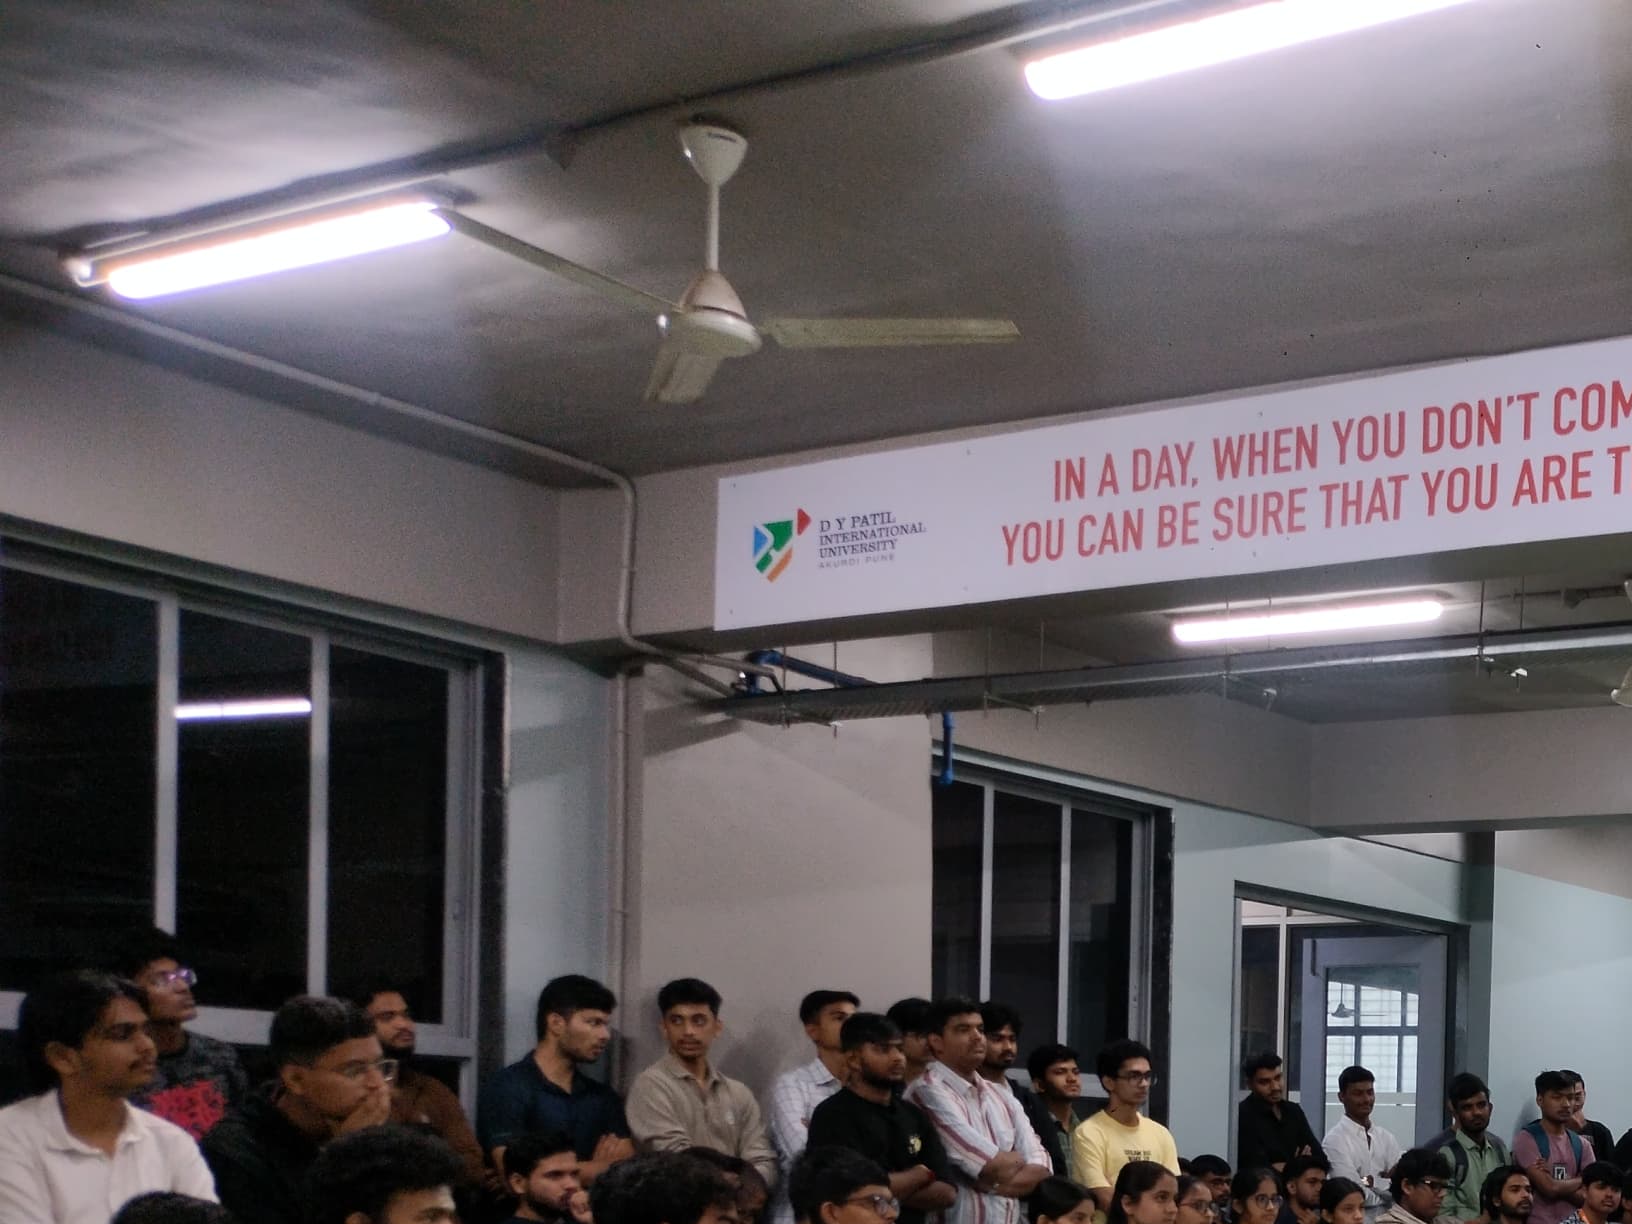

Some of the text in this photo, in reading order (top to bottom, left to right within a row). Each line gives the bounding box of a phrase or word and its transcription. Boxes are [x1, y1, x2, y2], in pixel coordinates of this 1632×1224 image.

[1054, 457, 1087, 503] IN
[1097, 454, 1120, 496] A
[1131, 442, 1200, 492] DAY,
[1212, 425, 1319, 481] WHEN
[1332, 411, 1406, 465] YOU
[1421, 391, 1540, 454] DON'T
[1002, 518, 1065, 566] YOU
[1076, 508, 1144, 558] CAN
[1156, 501, 1200, 549] BE
[1212, 487, 1307, 541] SURE
[1319, 474, 1409, 529] THAT
[1421, 462, 1499, 517] YOU
[1511, 449, 1594, 508] ARE
[819, 511, 897, 533] D Y PATIL
[819, 521, 927, 546] INTERNATIONAL
[818, 538, 898, 559] UNIVERSITY
[864, 553, 895, 564] PUNE
